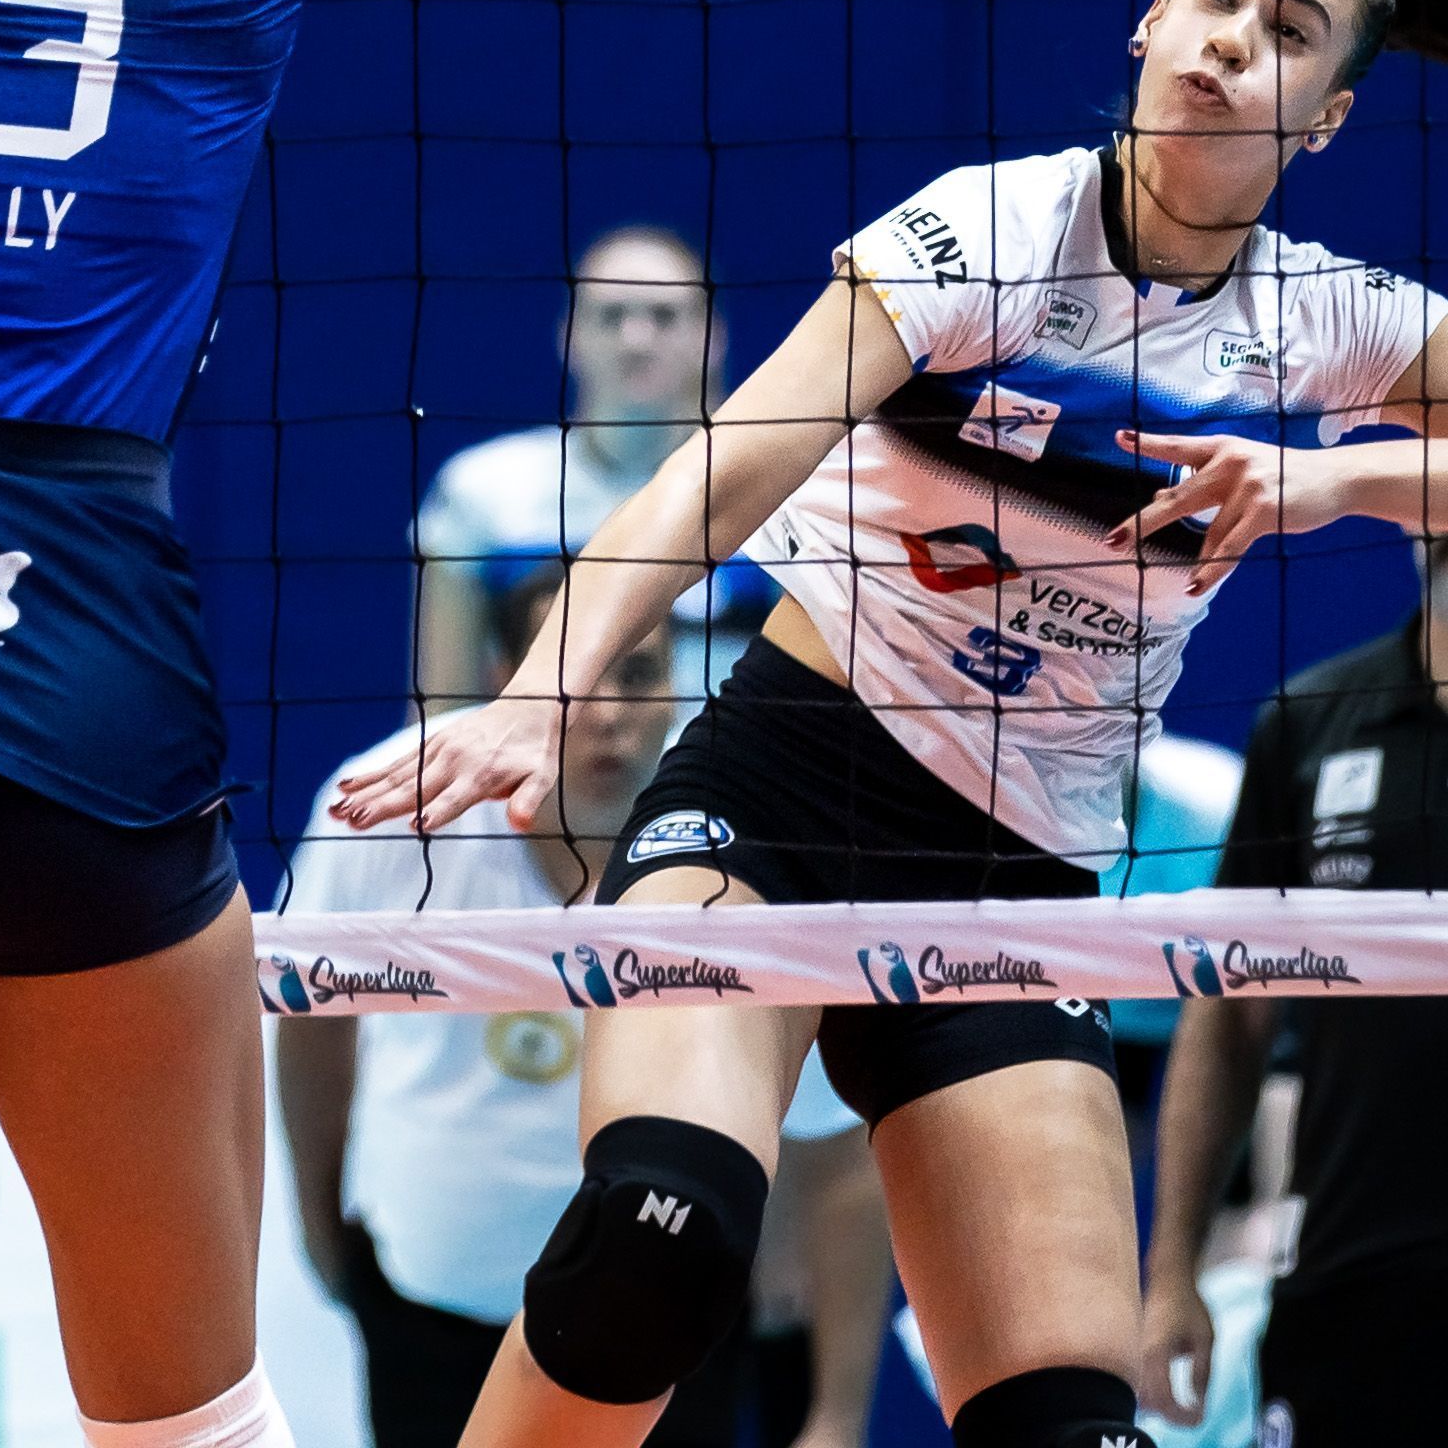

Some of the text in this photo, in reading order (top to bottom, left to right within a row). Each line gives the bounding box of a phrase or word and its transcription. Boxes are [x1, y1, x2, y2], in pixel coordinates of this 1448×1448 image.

[888, 207, 968, 290] HEINZ
[1007, 609, 1031, 637] &
[307, 956, 450, 1004] Superliga
[612, 948, 755, 999] Superliga
[917, 945, 1058, 996] Superliga
[1221, 939, 1362, 992] Superliga
